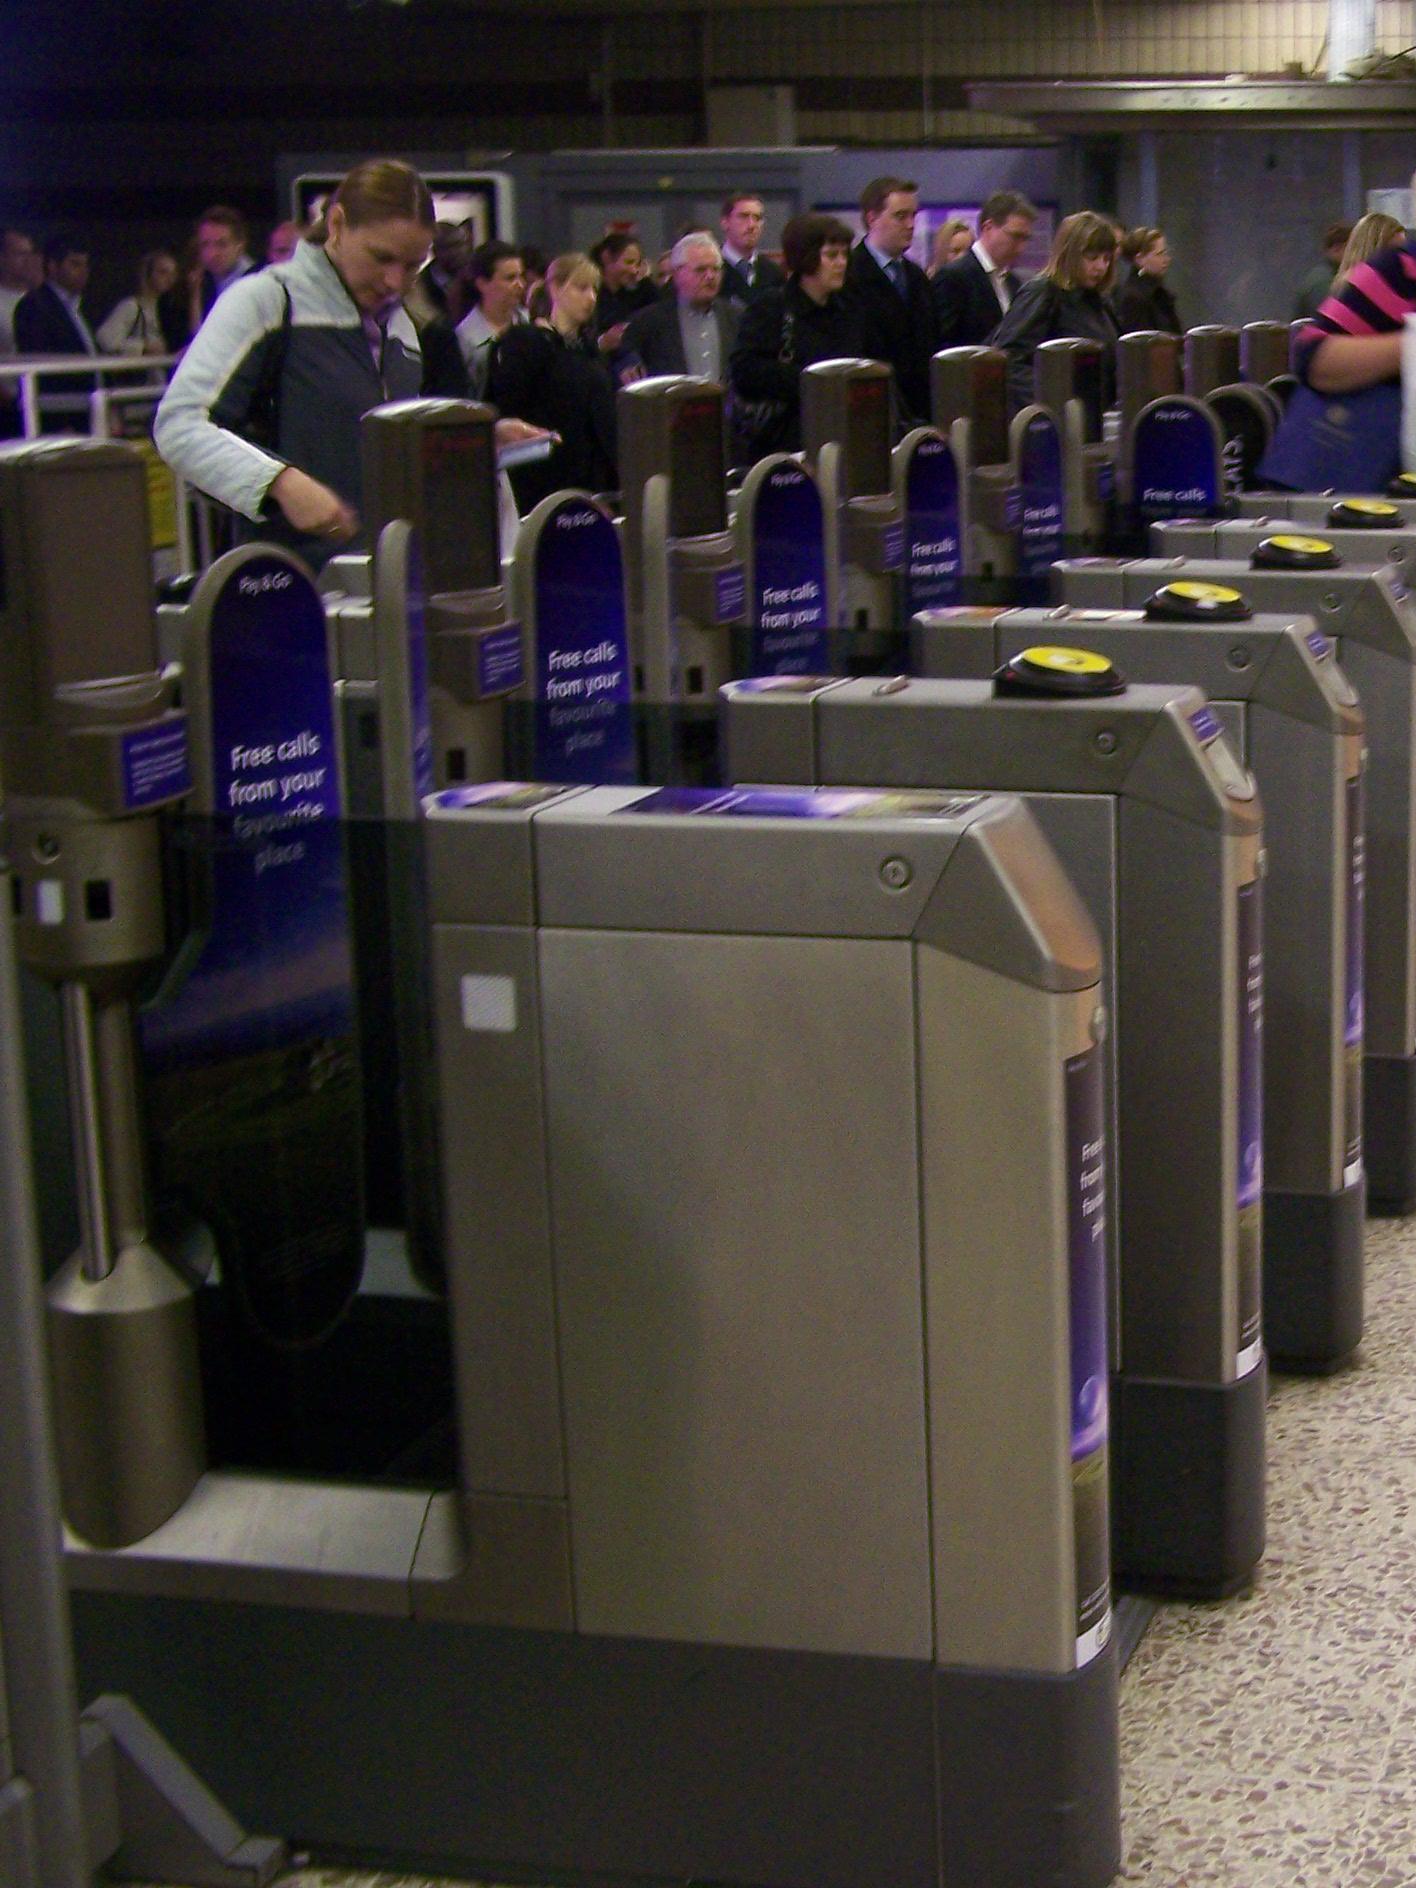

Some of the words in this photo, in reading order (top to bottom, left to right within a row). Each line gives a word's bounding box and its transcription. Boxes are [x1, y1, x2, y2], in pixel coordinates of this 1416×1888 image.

[240, 576, 261, 597] Pay
[272, 571, 293, 590] Go
[549, 650, 583, 672] Free
[583, 640, 618, 664] calls
[546, 676, 584, 700] from
[584, 671, 622, 698] your
[231, 744, 276, 771] Free
[277, 730, 321, 761] calls
[229, 779, 279, 807] from
[279, 767, 327, 802] your
